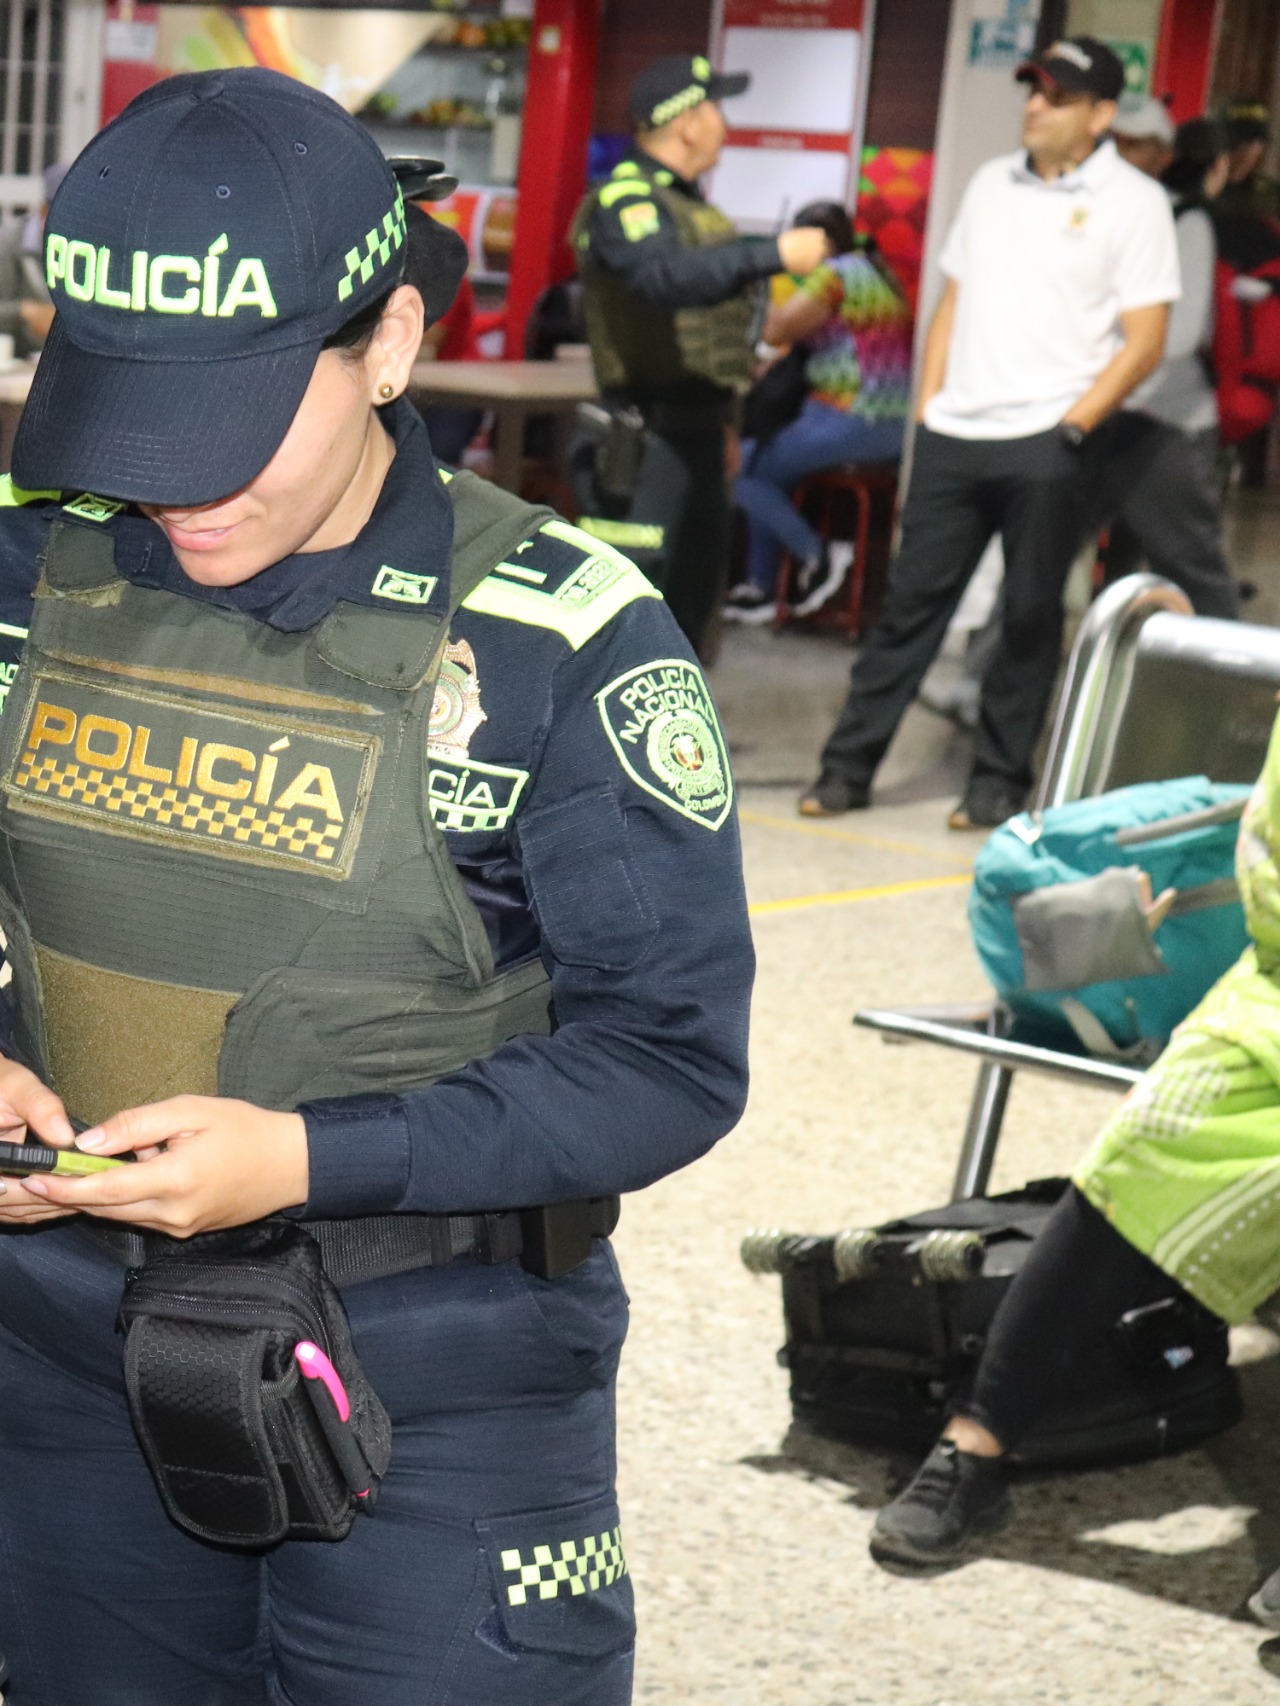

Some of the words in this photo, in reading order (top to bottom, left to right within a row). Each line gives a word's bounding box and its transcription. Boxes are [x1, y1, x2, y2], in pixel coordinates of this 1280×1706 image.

[46, 233, 278, 318] POLICÍA
[620, 667, 699, 710] POLICÍA
[620, 689, 713, 744] NACIONAL
[27, 702, 345, 822] POLICÍA
[428, 769, 496, 809] CÍA
